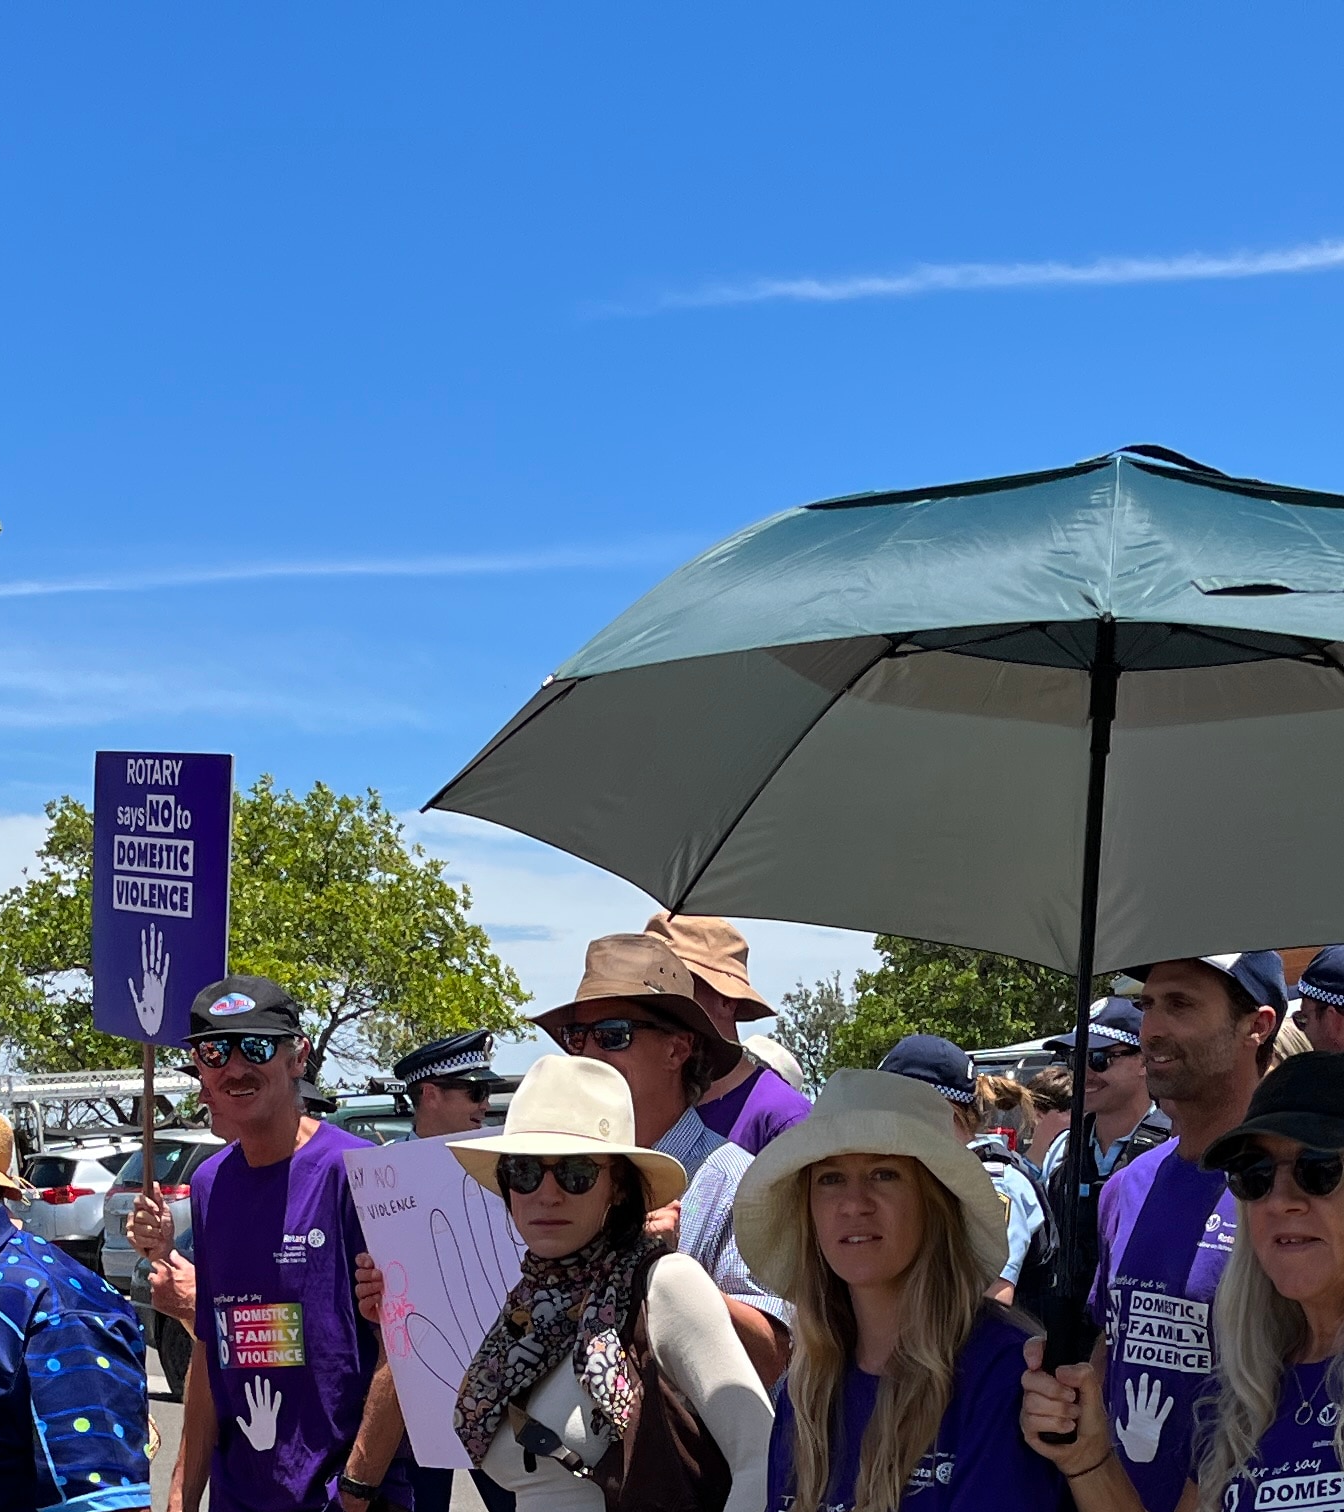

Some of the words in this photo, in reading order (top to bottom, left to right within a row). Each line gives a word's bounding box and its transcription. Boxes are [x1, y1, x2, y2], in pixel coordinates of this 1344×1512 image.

[126, 758, 183, 786] ROTARY
[116, 806, 145, 832] says
[149, 799, 172, 828] NO
[176, 804, 192, 830] to
[117, 840, 190, 872] DOMESTIC
[116, 880, 189, 912] VIOLENCE
[367, 1196, 418, 1220] VIOLENCE
[233, 1308, 289, 1322] DOMESTIC
[1133, 1296, 1194, 1320] DOMESTIC
[236, 1328, 299, 1344] FAMILY
[1128, 1320, 1206, 1344] FAMLY
[236, 1350, 303, 1364] VIOLENCE
[1126, 1344, 1208, 1369] VIOLENCE
[1270, 1462, 1290, 1476] we
[1294, 1458, 1322, 1473] say
